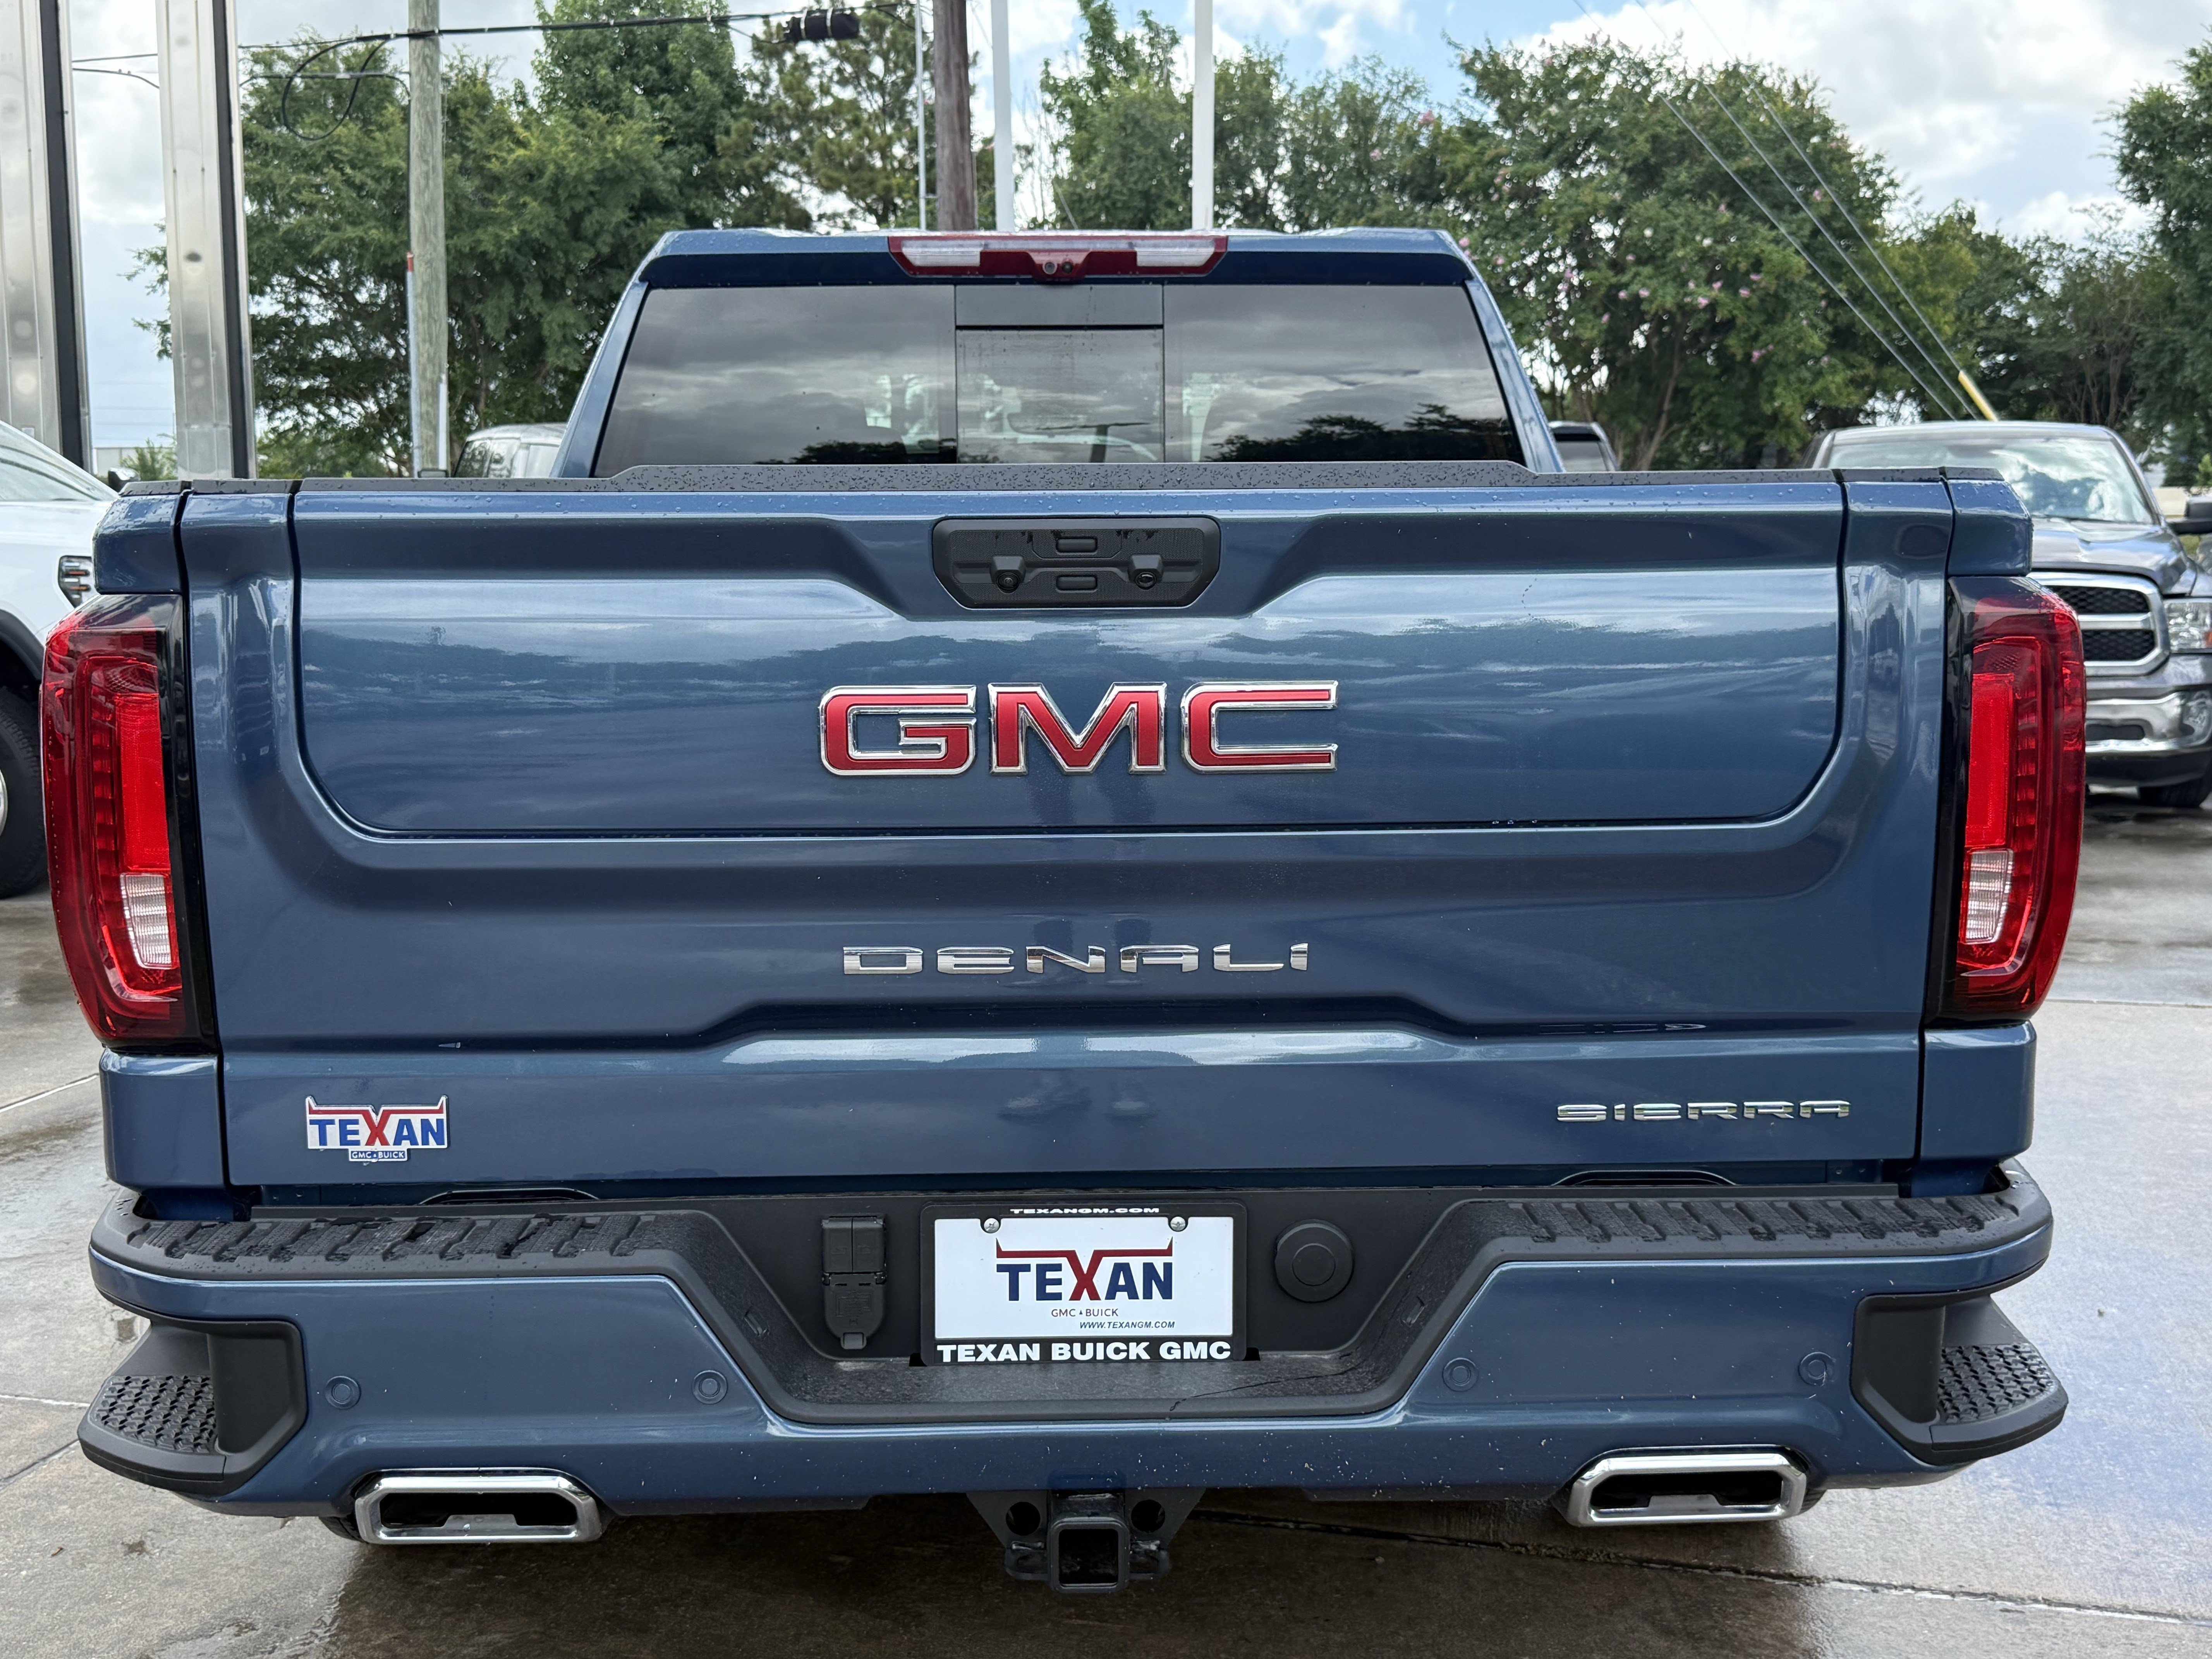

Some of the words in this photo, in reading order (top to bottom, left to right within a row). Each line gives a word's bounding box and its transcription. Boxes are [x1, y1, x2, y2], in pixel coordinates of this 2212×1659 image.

[818, 680, 1339, 776] GMC
[843, 943, 1309, 974] DENALI
[1557, 1100, 1851, 1121] SIERRA
[309, 1109, 444, 1146] TEXAN
[996, 1249, 1173, 1301] TEXAN
[1051, 1309, 1076, 1317] GMC
[1085, 1308, 1119, 1317] BUICK
[1080, 1321, 1175, 1329] WWW.TEXANGM.COM
[937, 1343, 1040, 1362] TEXAN
[1051, 1342, 1150, 1360] BUICK
[1159, 1341, 1231, 1359] GMC
